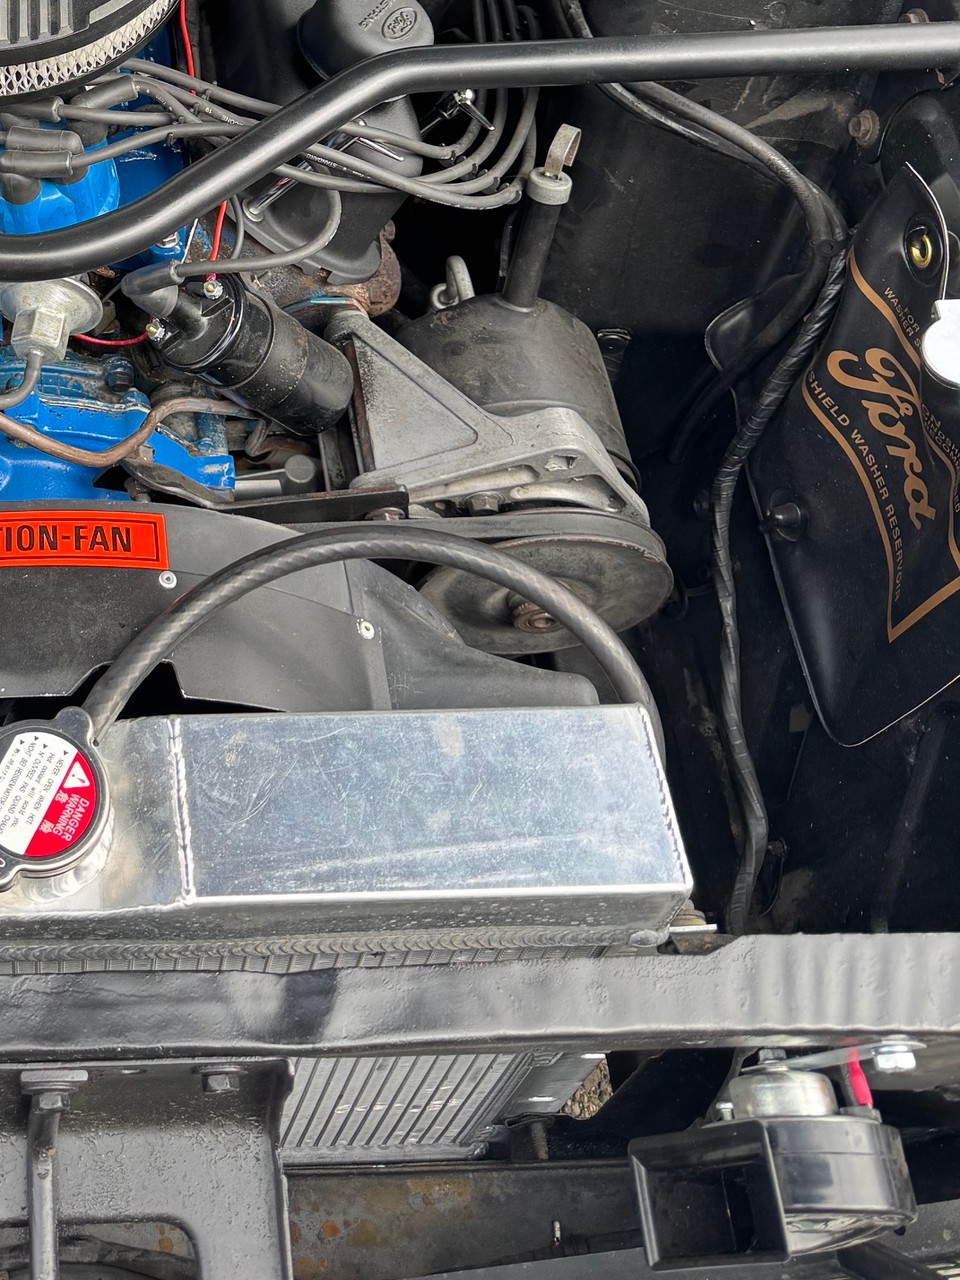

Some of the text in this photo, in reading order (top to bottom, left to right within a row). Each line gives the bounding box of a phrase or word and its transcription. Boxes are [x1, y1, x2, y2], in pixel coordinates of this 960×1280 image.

[387, 10, 413, 36] Ford
[884, 287, 914, 337] WASHER
[826, 347, 936, 530] Ford
[850, 429, 890, 501] WASHER
[885, 503, 903, 603] RESERVOIR
[45, 752, 55, 763] Hot
[50, 757, 64, 776] NEVER
[27, 786, 37, 798] will
[51, 792, 81, 836] WARNING
[60, 797, 90, 842] DANGER
